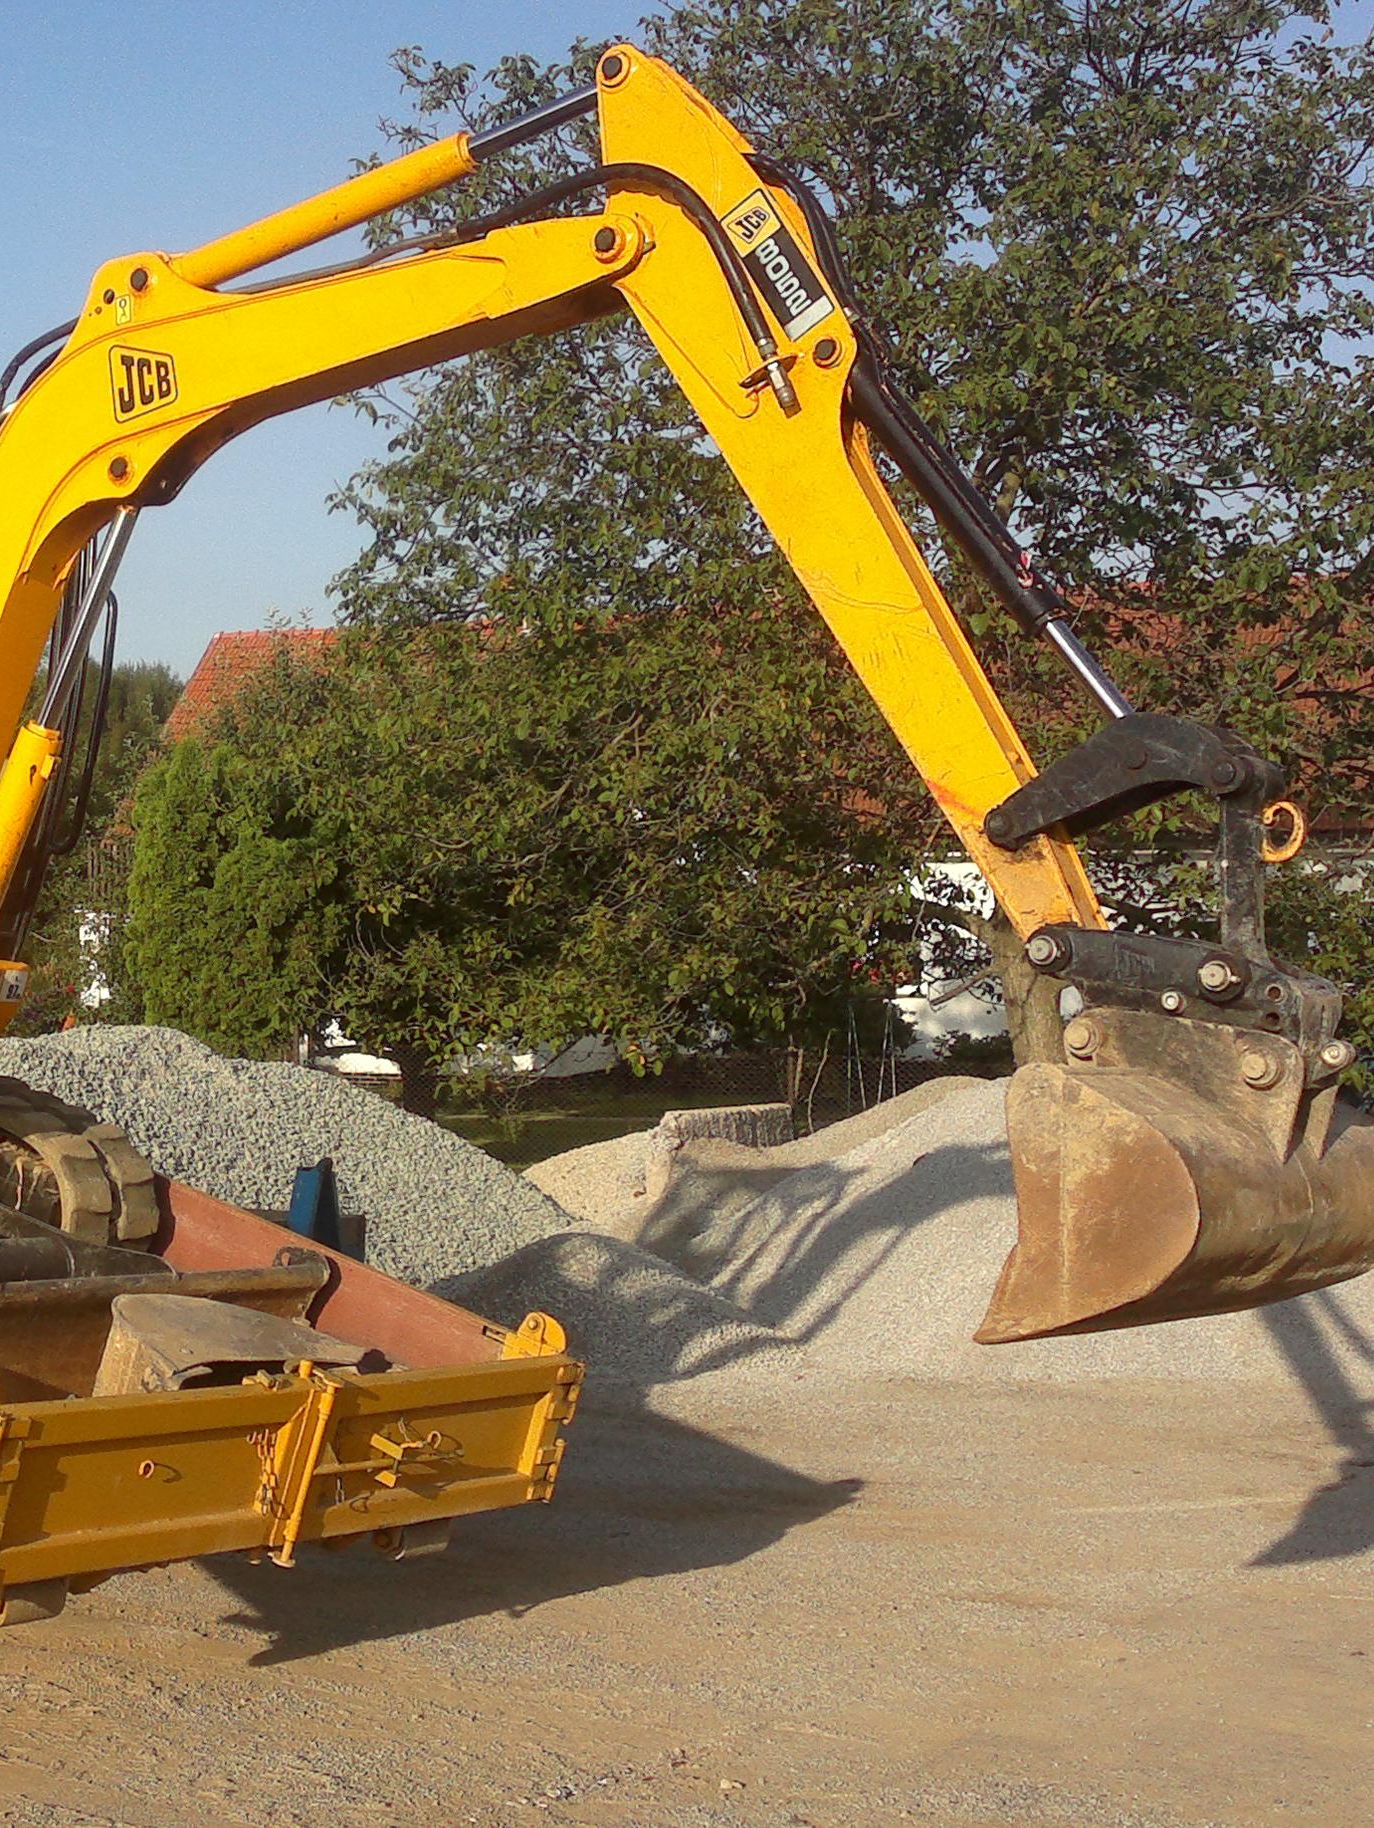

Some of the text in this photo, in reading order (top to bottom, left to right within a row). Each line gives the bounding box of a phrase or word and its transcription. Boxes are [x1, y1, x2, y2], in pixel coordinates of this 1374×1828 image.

[734, 208, 813, 317] JCB 8052
[118, 354, 172, 414] JCB
